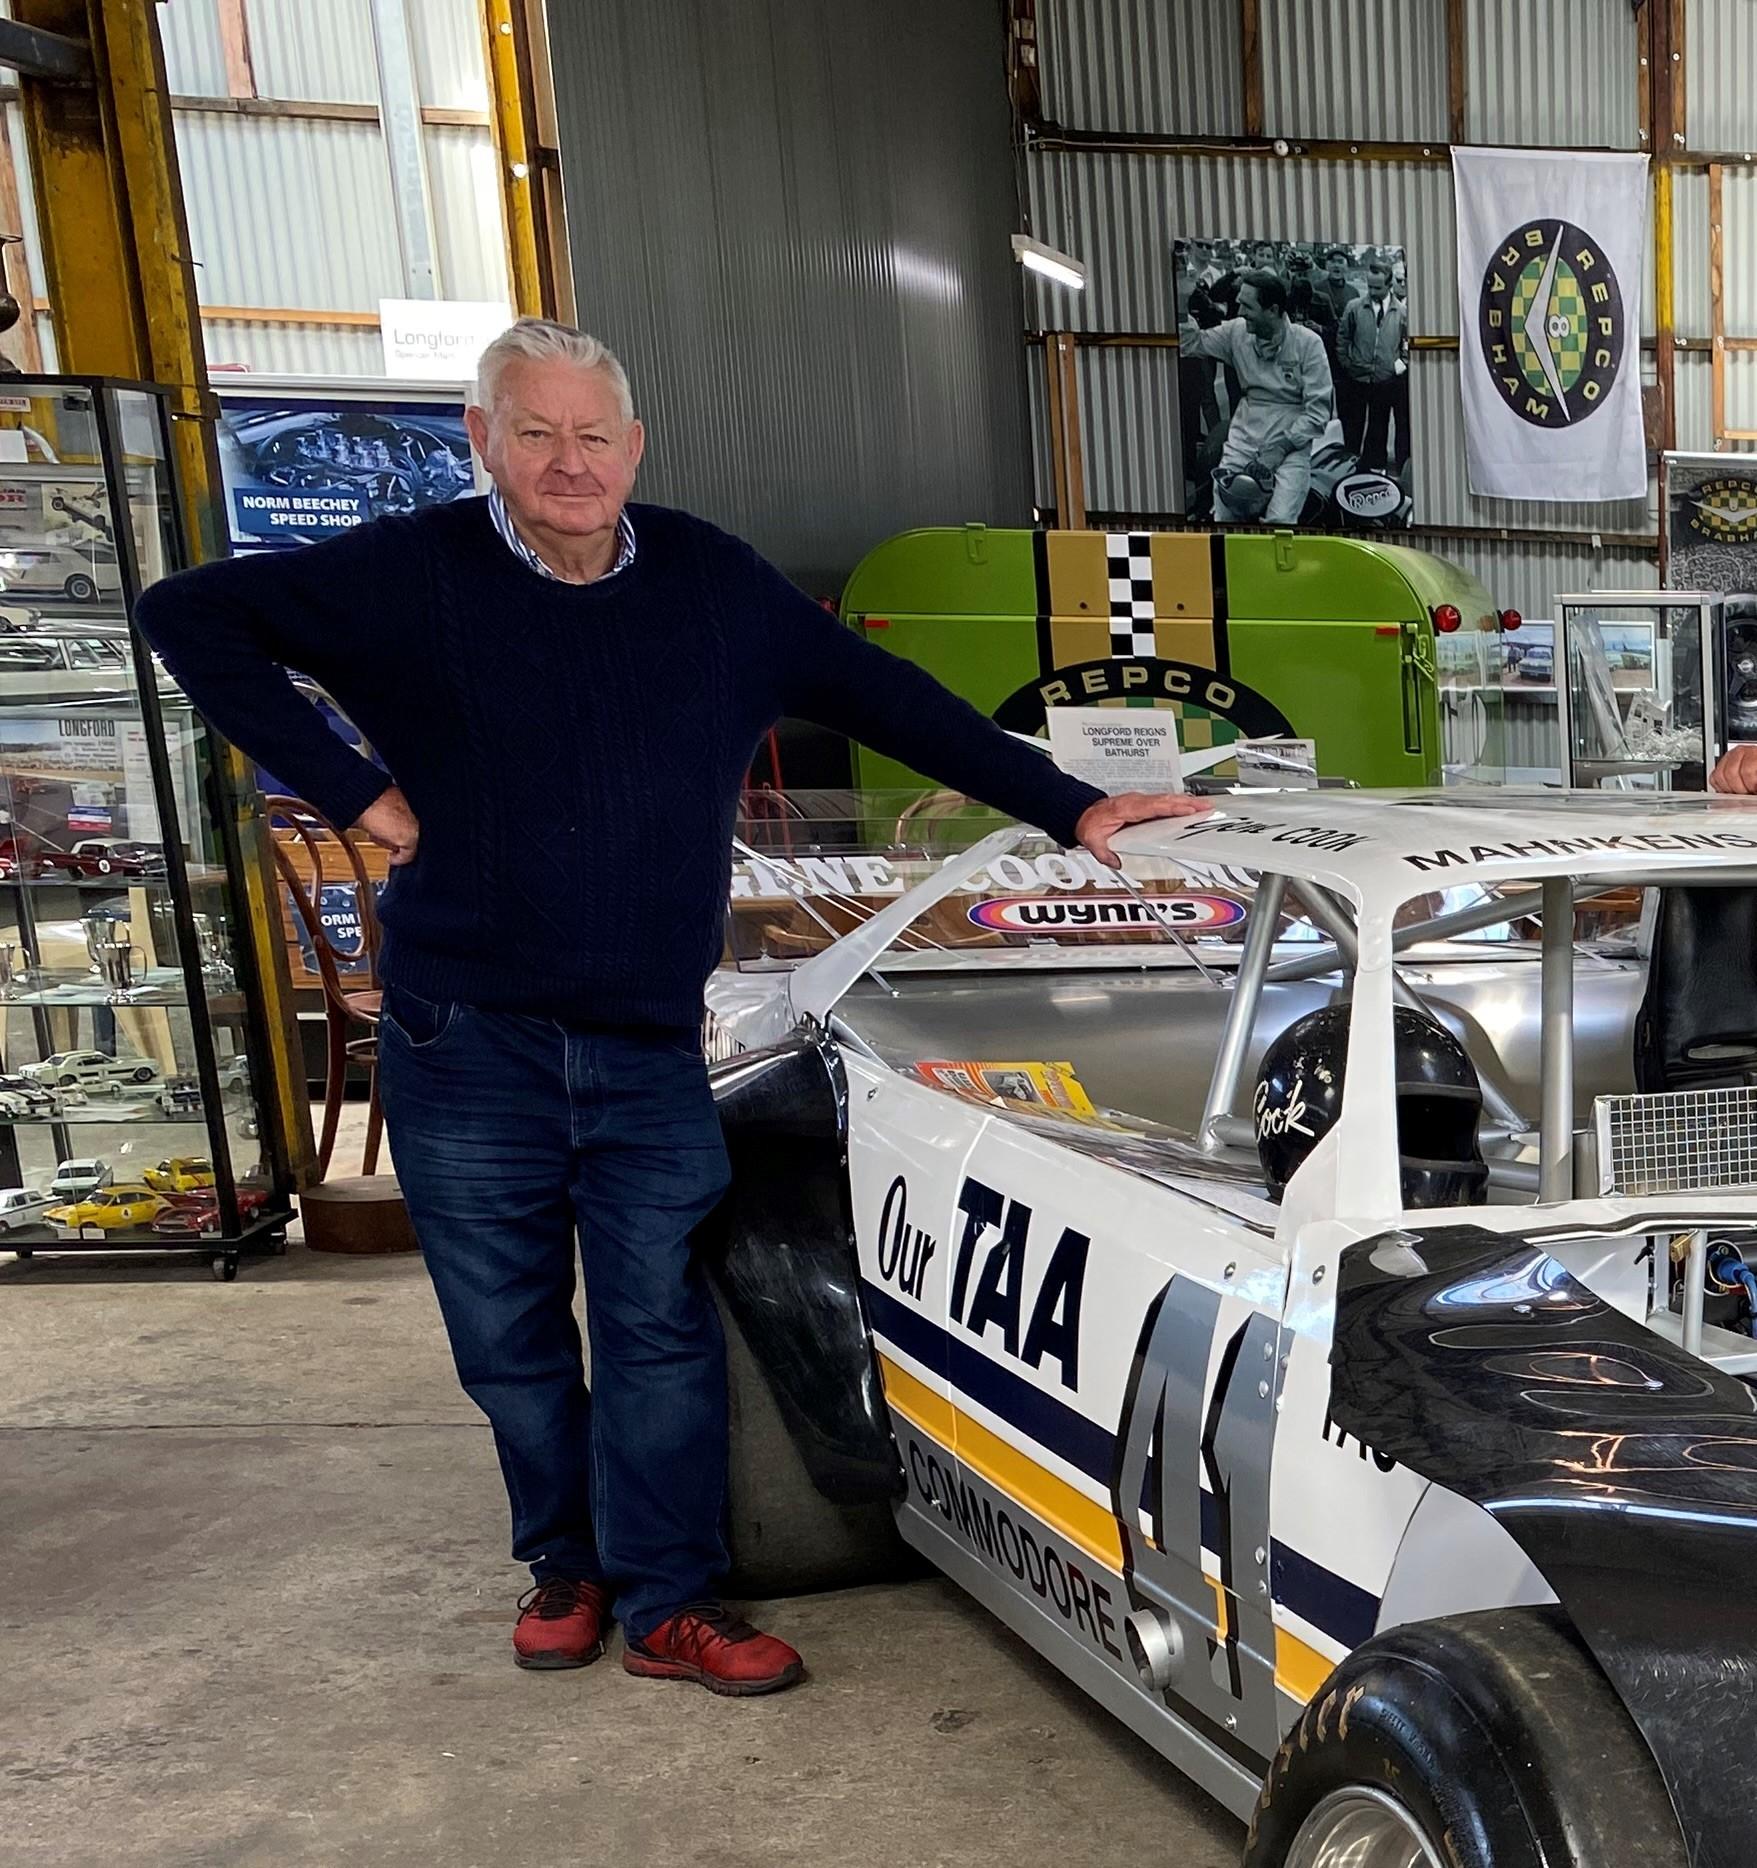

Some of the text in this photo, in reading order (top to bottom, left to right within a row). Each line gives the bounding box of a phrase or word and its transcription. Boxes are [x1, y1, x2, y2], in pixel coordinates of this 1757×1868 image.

[1488, 228, 1549, 420] BRABHAM
[1575, 247, 1614, 402] REPCO
[1701, 479, 1757, 495] REPC
[242, 495, 360, 511] NORM BEECHEY
[270, 513, 362, 527] SPEED SHOP
[1039, 665, 1237, 710] REPCO
[58, 719, 116, 737] LONGFORD
[1082, 727, 1167, 737] LONGFORD REIGNS
[1092, 738, 1161, 747] SUPREME OVER
[1105, 748, 1150, 758] BATHURST
[1401, 832, 1757, 871] MAHNKENS
[320, 913, 356, 926] ORM
[337, 926, 363, 939] SPE
[878, 1175, 1091, 1394] Our TAA
[909, 1440, 1124, 1663] COMMODORE
